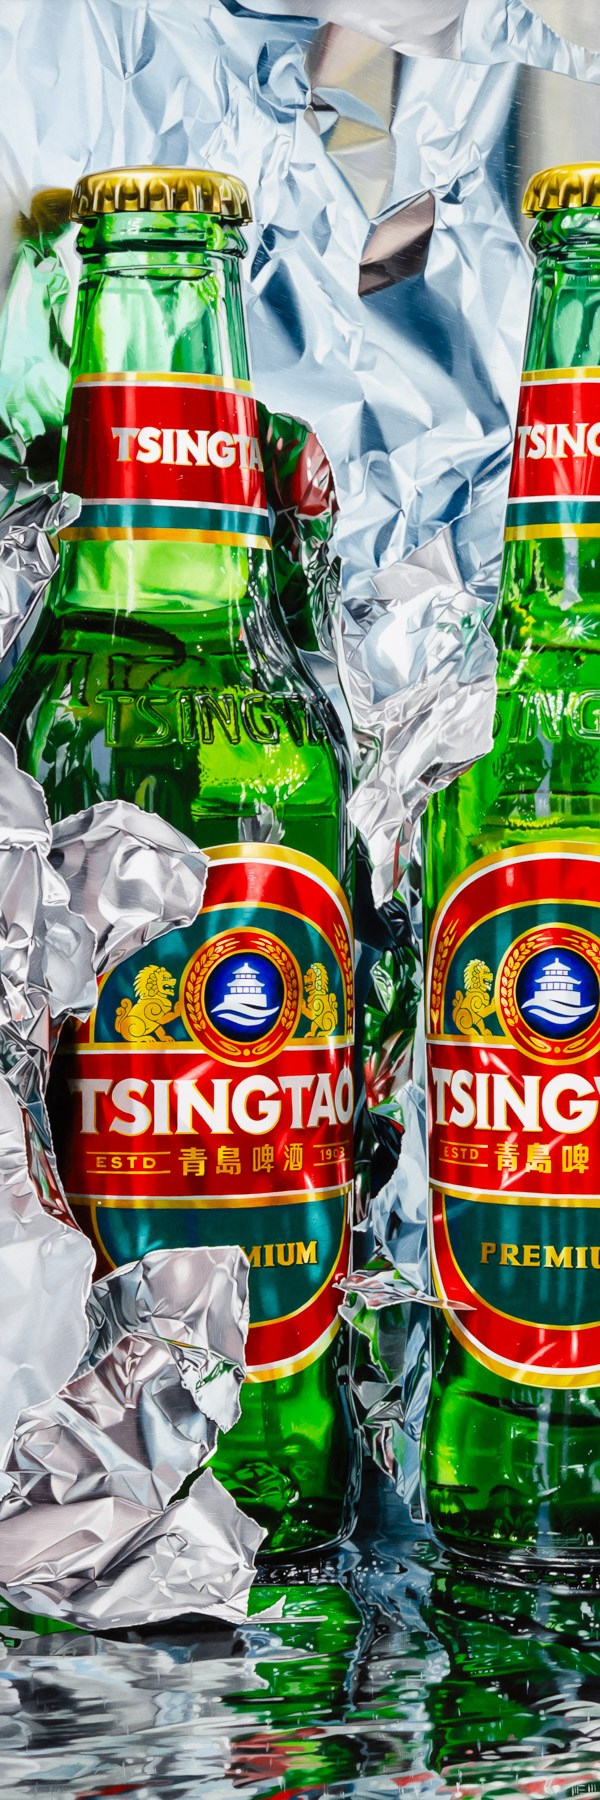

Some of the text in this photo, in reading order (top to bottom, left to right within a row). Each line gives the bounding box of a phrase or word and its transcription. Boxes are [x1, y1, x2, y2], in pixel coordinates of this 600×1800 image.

[111, 426, 264, 472] TSINGTA
[69, 1066, 354, 1136] TSINGTAO
[432, 1066, 600, 1134] TSING
[95, 1142, 345, 1177] ESTD 青島啤酒 1903
[443, 1140, 590, 1175] ESTD 青島啤
